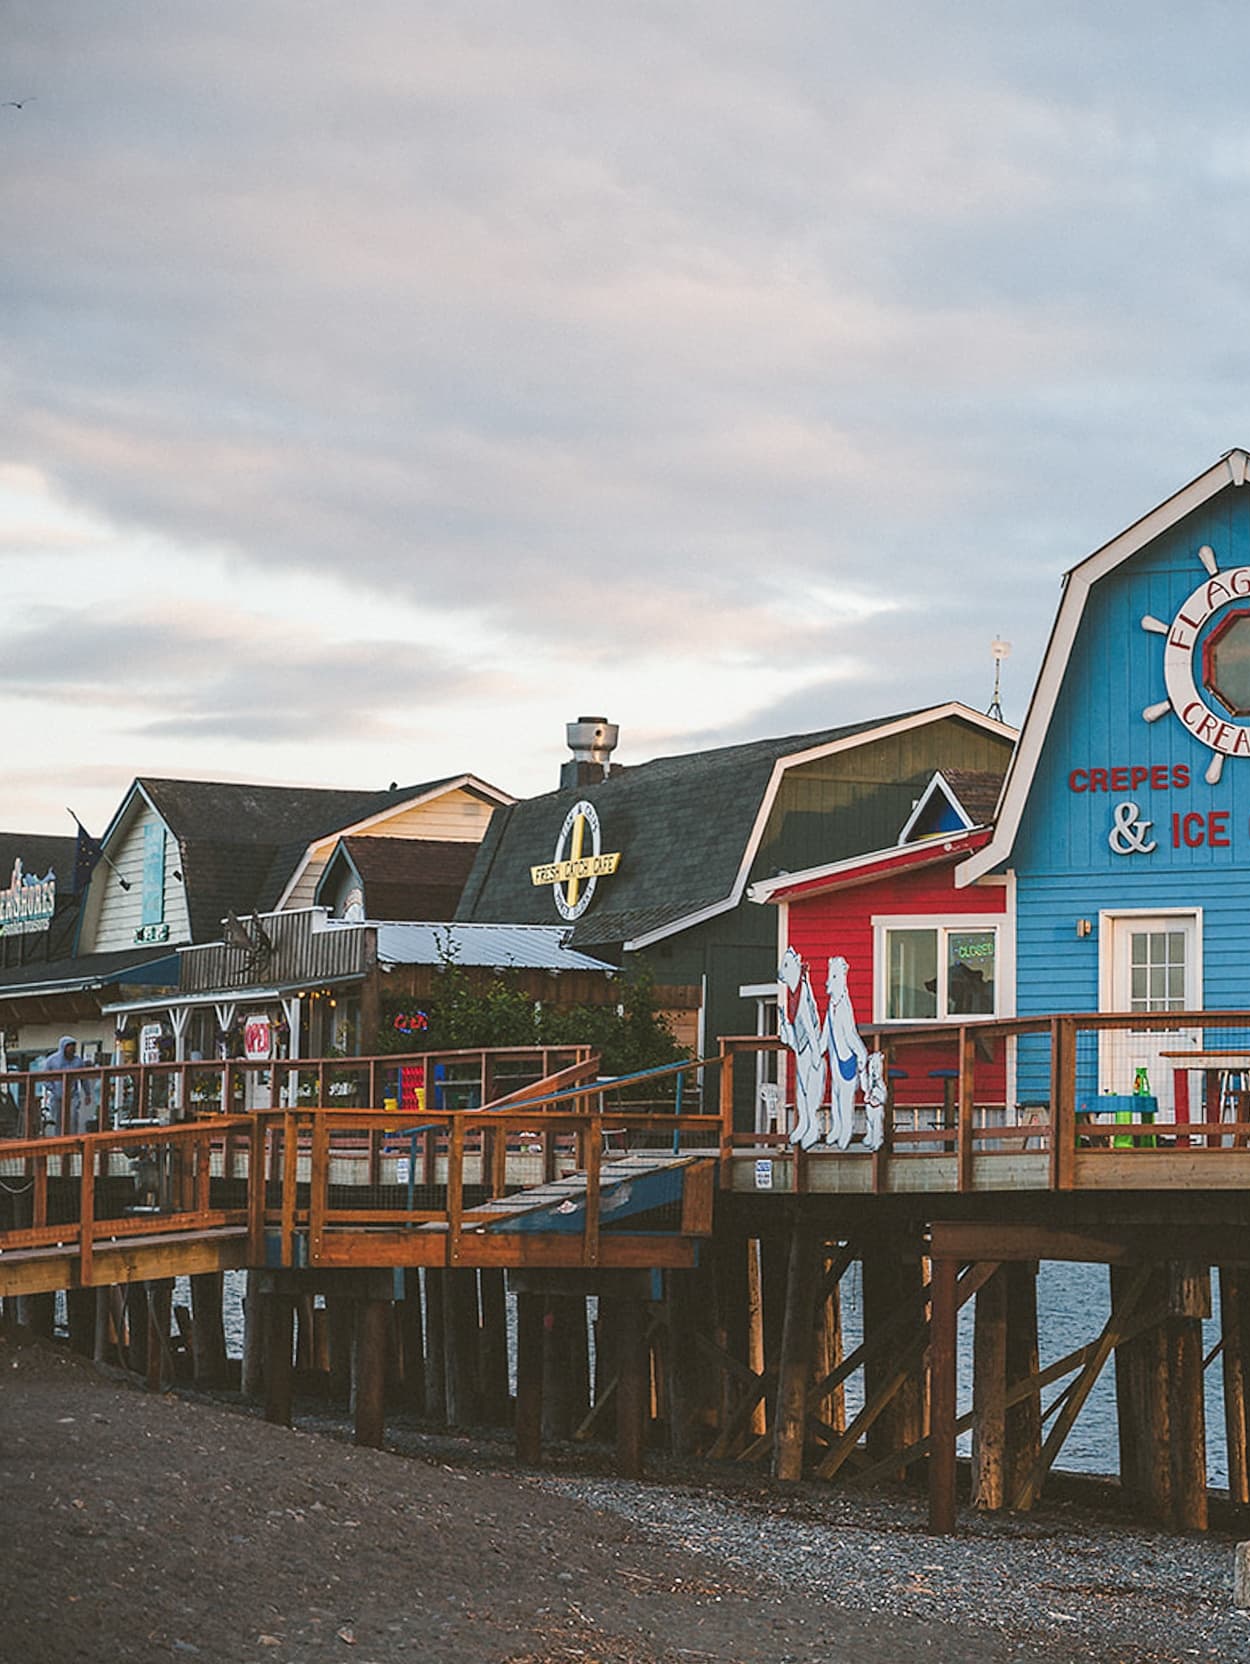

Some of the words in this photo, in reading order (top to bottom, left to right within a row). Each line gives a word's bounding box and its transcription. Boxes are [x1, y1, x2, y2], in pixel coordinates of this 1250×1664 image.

[1068, 764, 1191, 793] CREPES
[1108, 802, 1157, 855] &
[1172, 811, 1231, 848] ICE
[536, 866, 560, 882] FRESH
[565, 860, 590, 877] CATCH
[593, 856, 614, 873] CAFE
[959, 943, 994, 958] CLOSED
